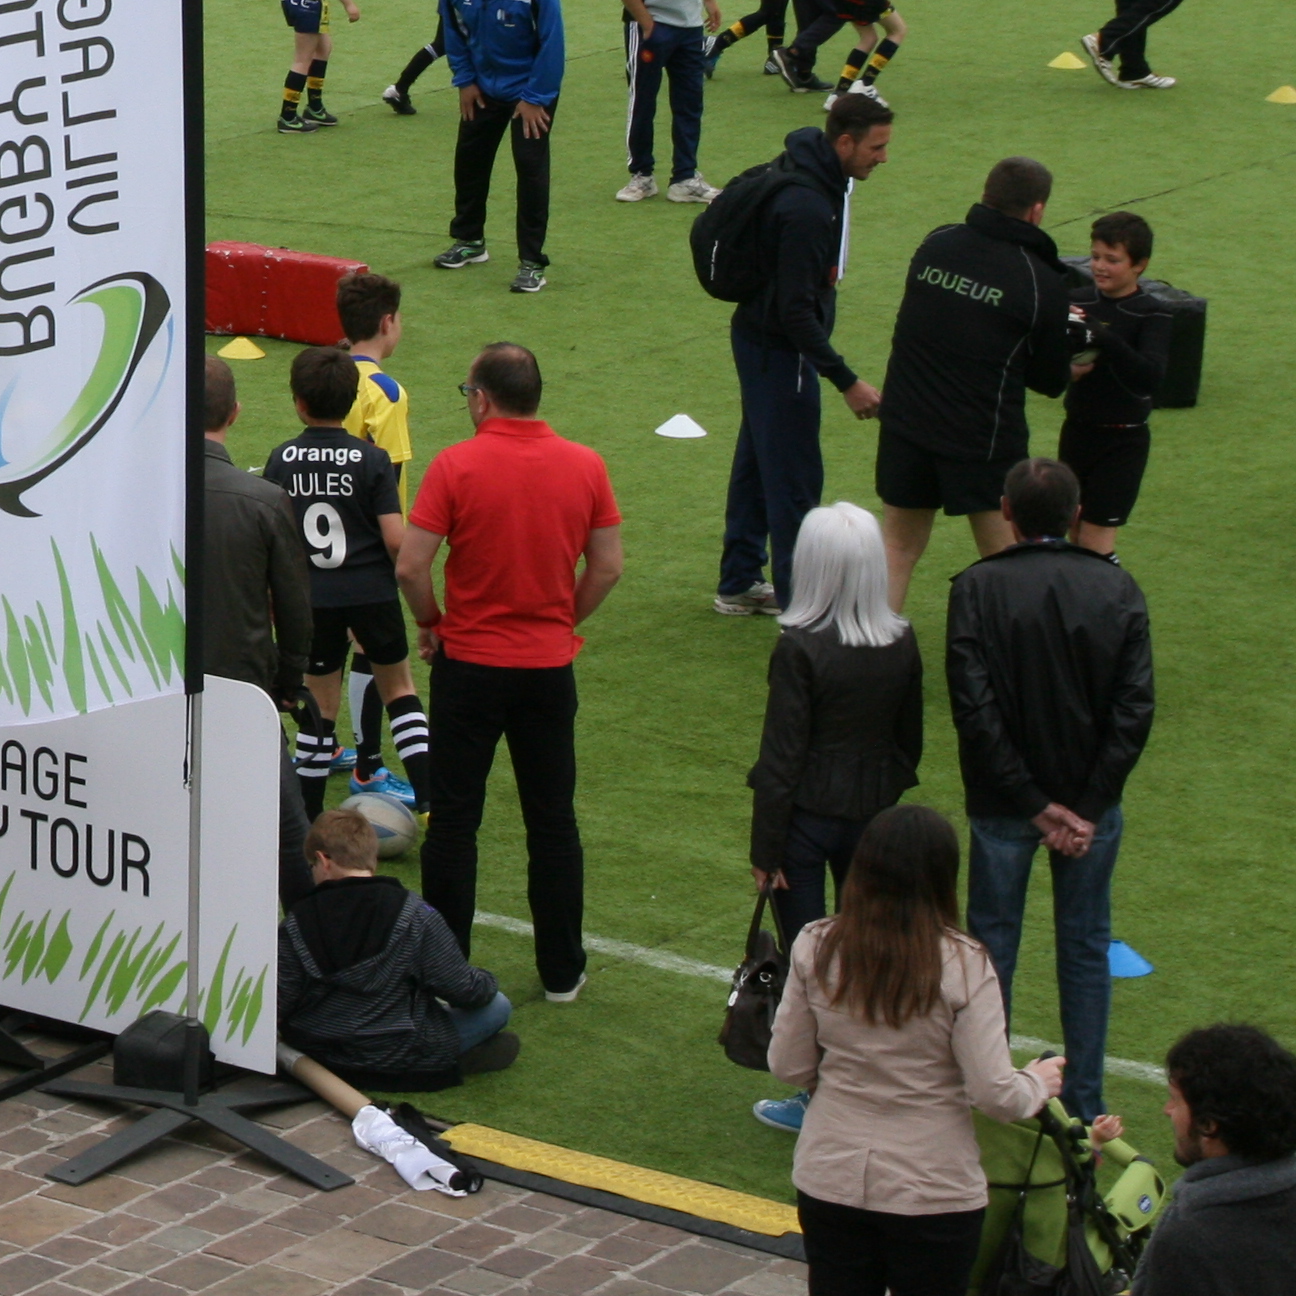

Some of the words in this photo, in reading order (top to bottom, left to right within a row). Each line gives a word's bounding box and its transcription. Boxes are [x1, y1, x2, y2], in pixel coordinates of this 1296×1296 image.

[917, 265, 1004, 306] JOUEUR
[282, 445, 362, 466] Orange
[288, 472, 353, 497] JULES
[303, 502, 347, 570] 9
[20, 808, 151, 898] TOUR
